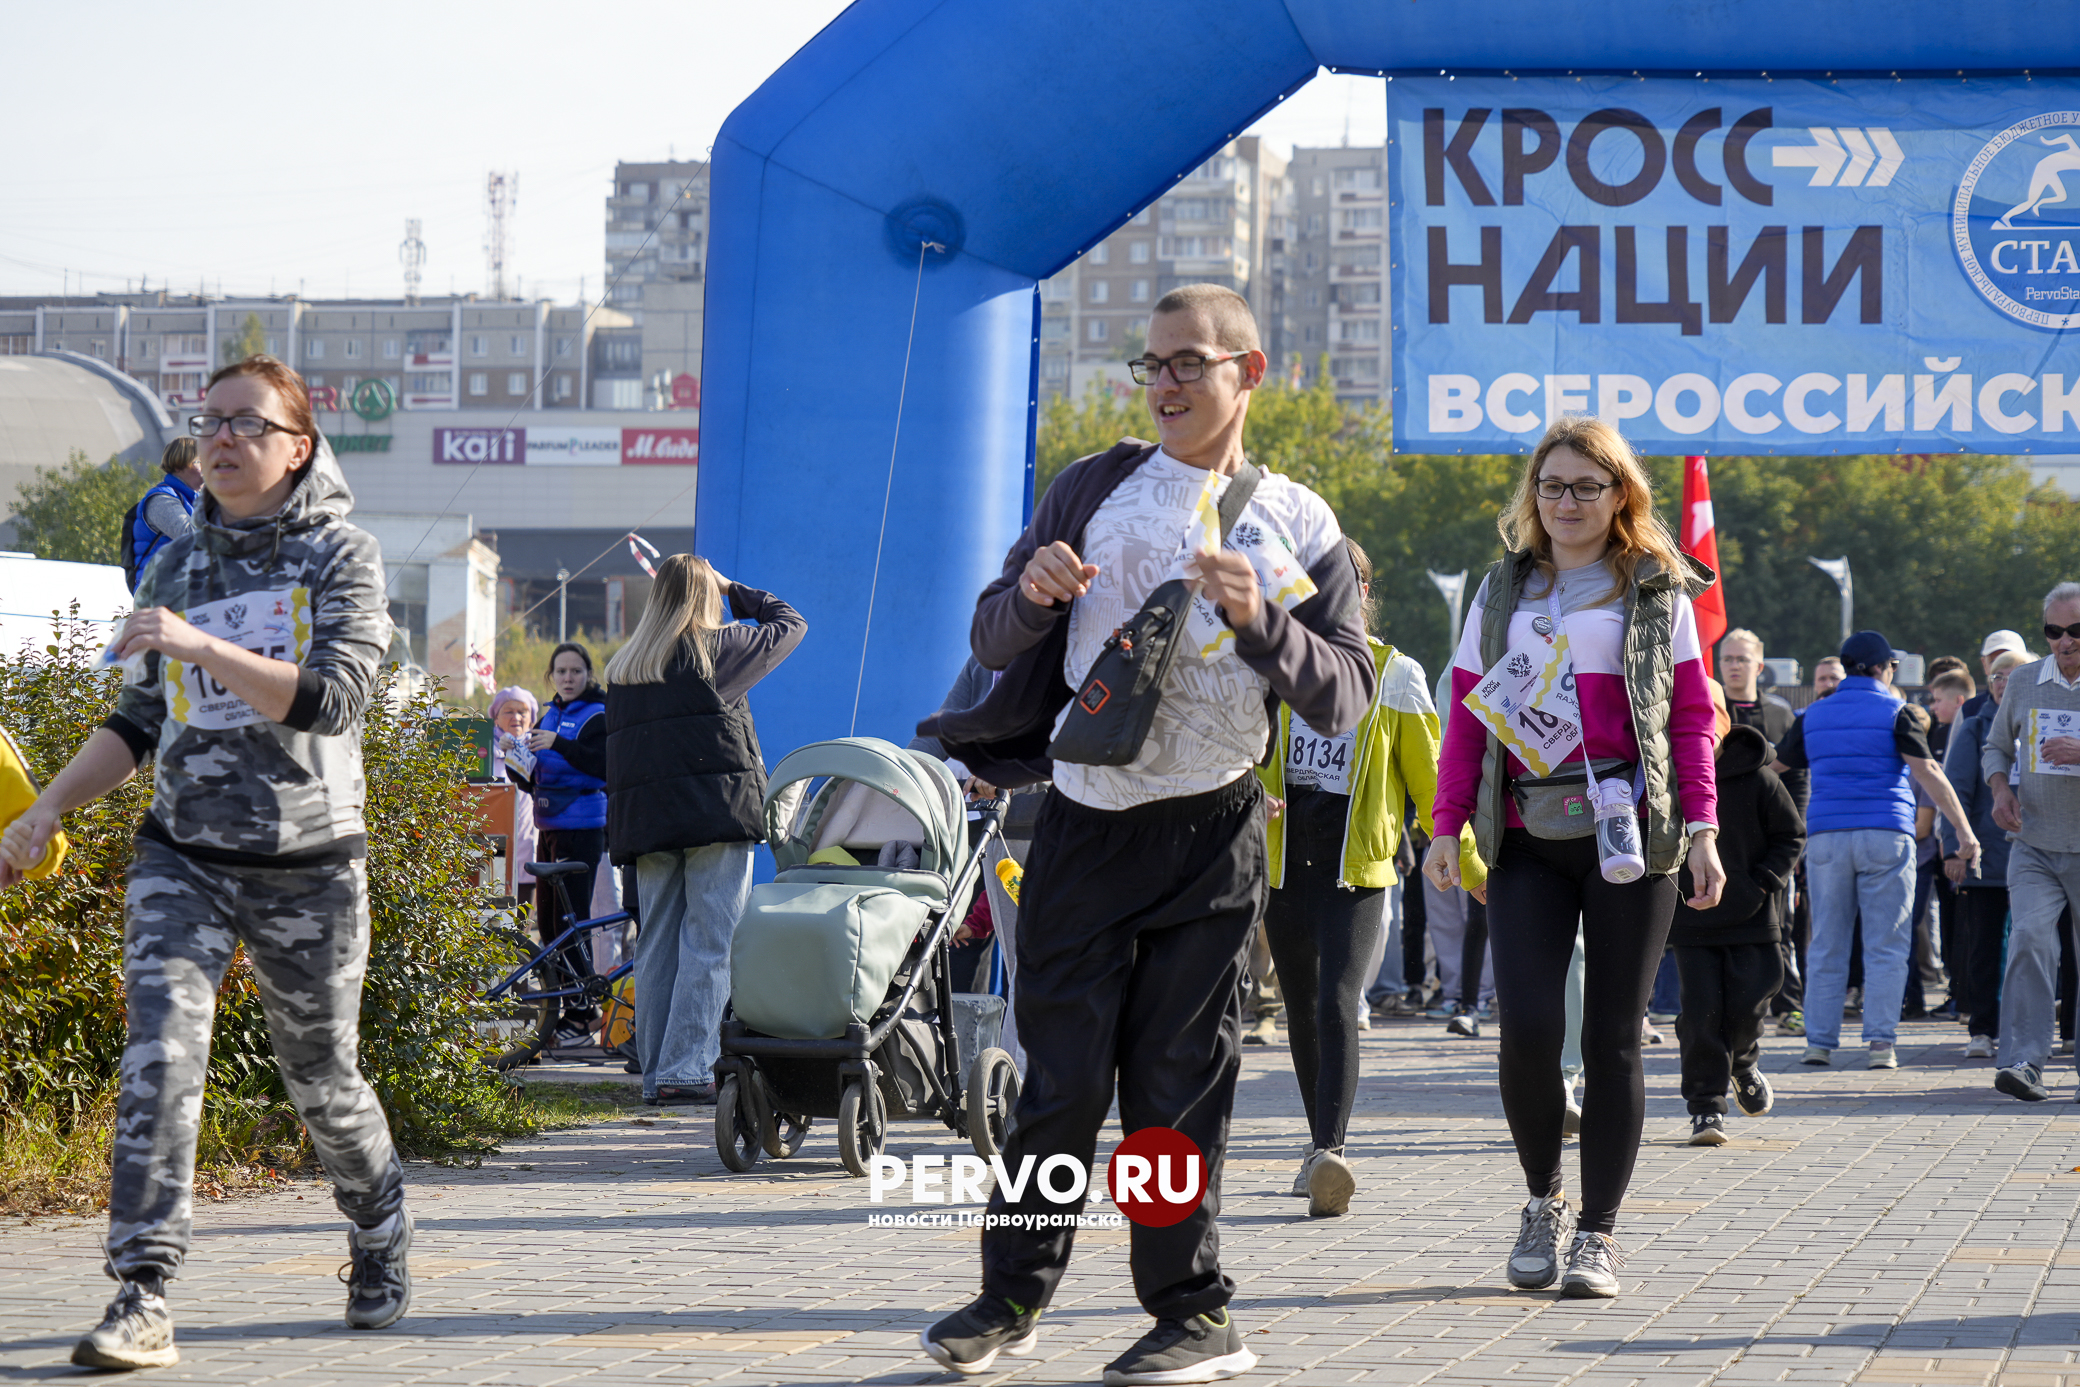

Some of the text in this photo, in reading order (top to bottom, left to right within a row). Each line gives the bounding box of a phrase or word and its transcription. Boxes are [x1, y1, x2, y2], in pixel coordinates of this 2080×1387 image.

[1423, 107, 1773, 207] КРОСС
[1995, 111, 2068, 148] БЮДЖЕТНОЕ
[1954, 146, 1995, 254] МУНИЦИПАЛЬНОЕ
[1427, 225, 1884, 336] НАЦИИ
[1963, 253, 2050, 326] ПЕРВОУРАЛЬСКОЕ
[442, 430, 516, 461] kari
